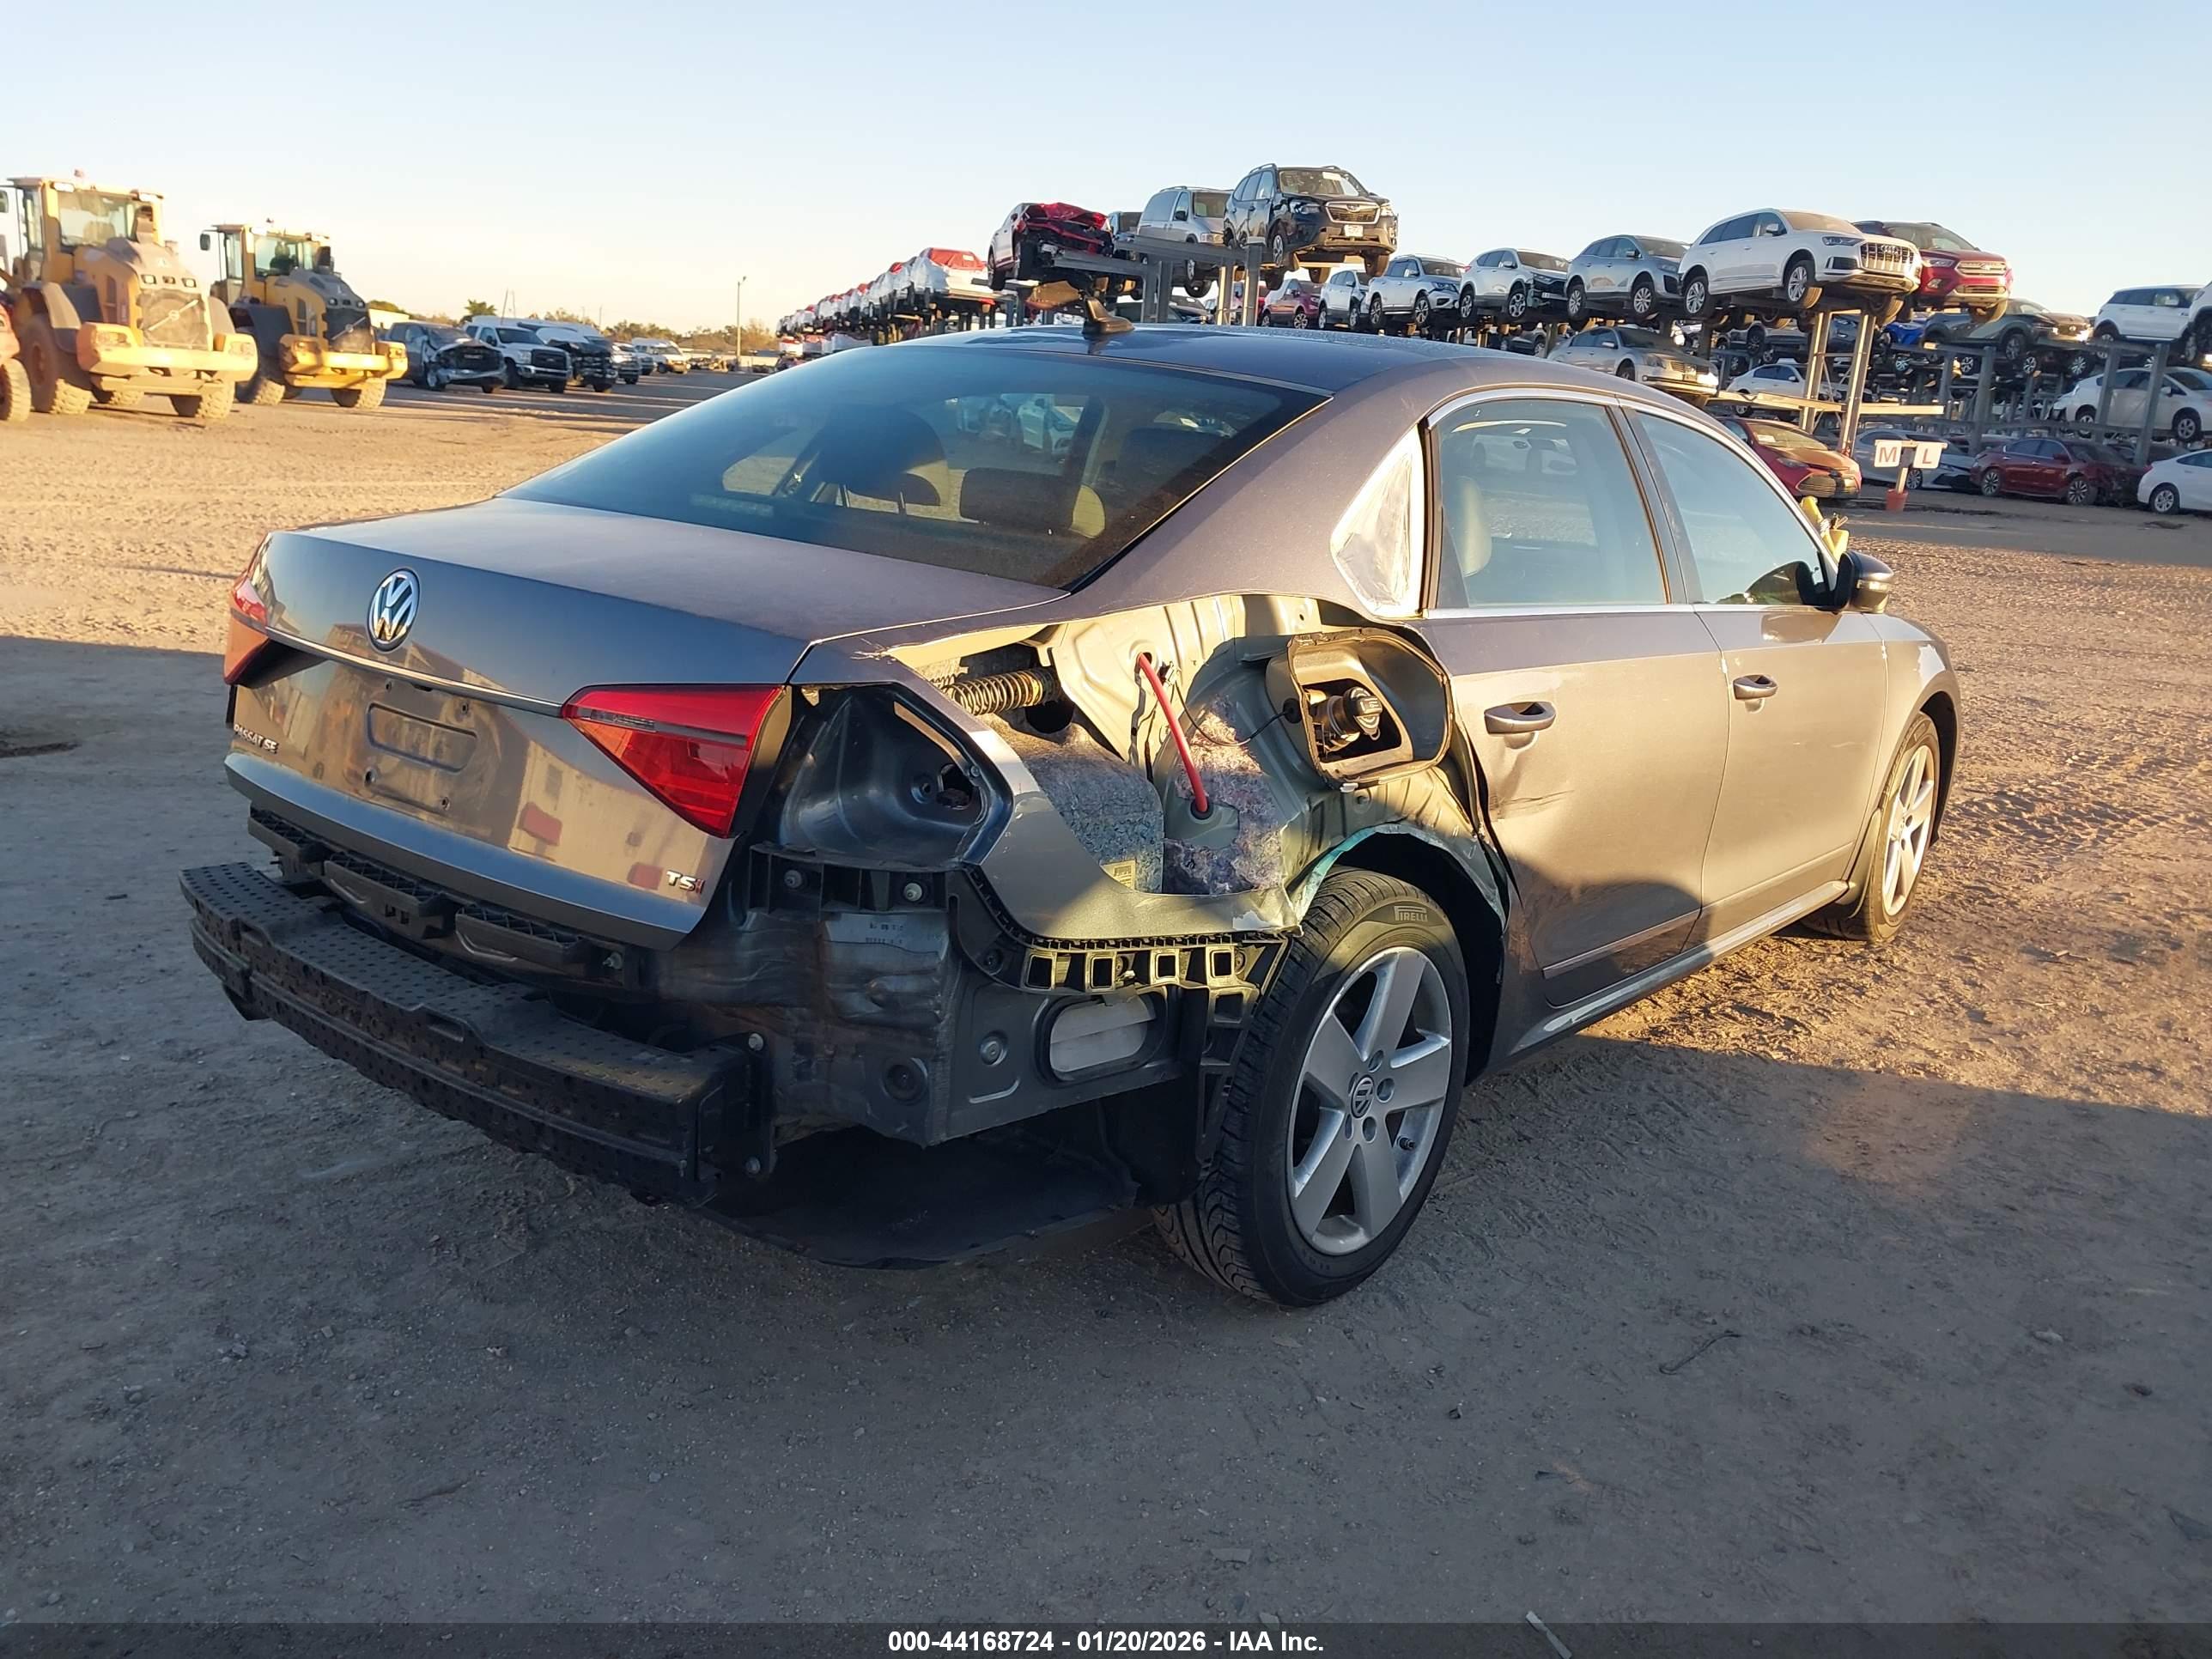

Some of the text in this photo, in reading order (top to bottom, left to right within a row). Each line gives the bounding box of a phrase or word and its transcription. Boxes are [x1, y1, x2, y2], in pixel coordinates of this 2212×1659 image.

[1879, 447, 1897, 463] M
[1923, 448, 1932, 465] L
[264, 738, 279, 754] SE
[1394, 905, 1428, 922] PIRELLI
